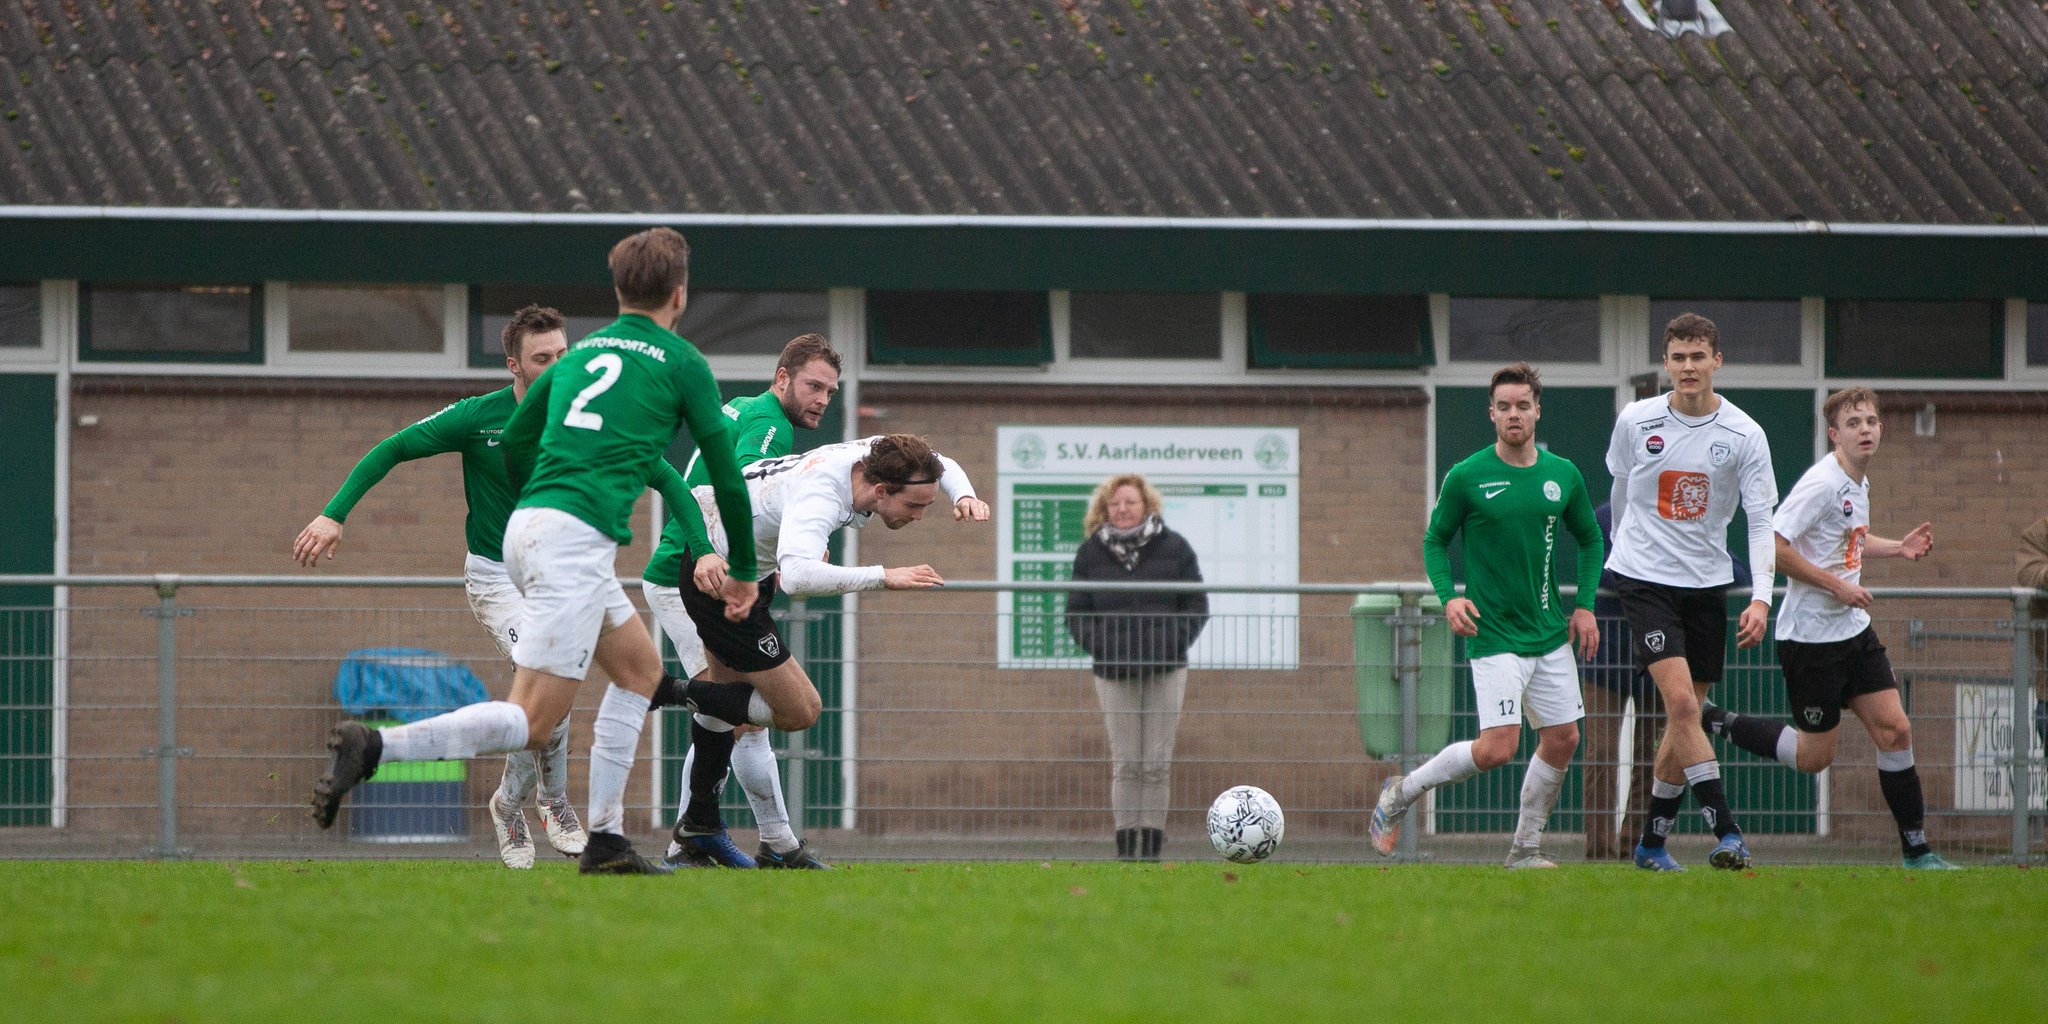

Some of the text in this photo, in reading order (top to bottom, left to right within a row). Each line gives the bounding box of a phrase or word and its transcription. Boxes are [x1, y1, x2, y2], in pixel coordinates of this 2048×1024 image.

[563, 352, 623, 431] 2
[1057, 443, 1243, 460] S.V. Aarlanderveen
[1541, 515, 1557, 611] PLUTOSPORT
[508, 628, 518, 642] 8
[1498, 700, 1515, 716] 12
